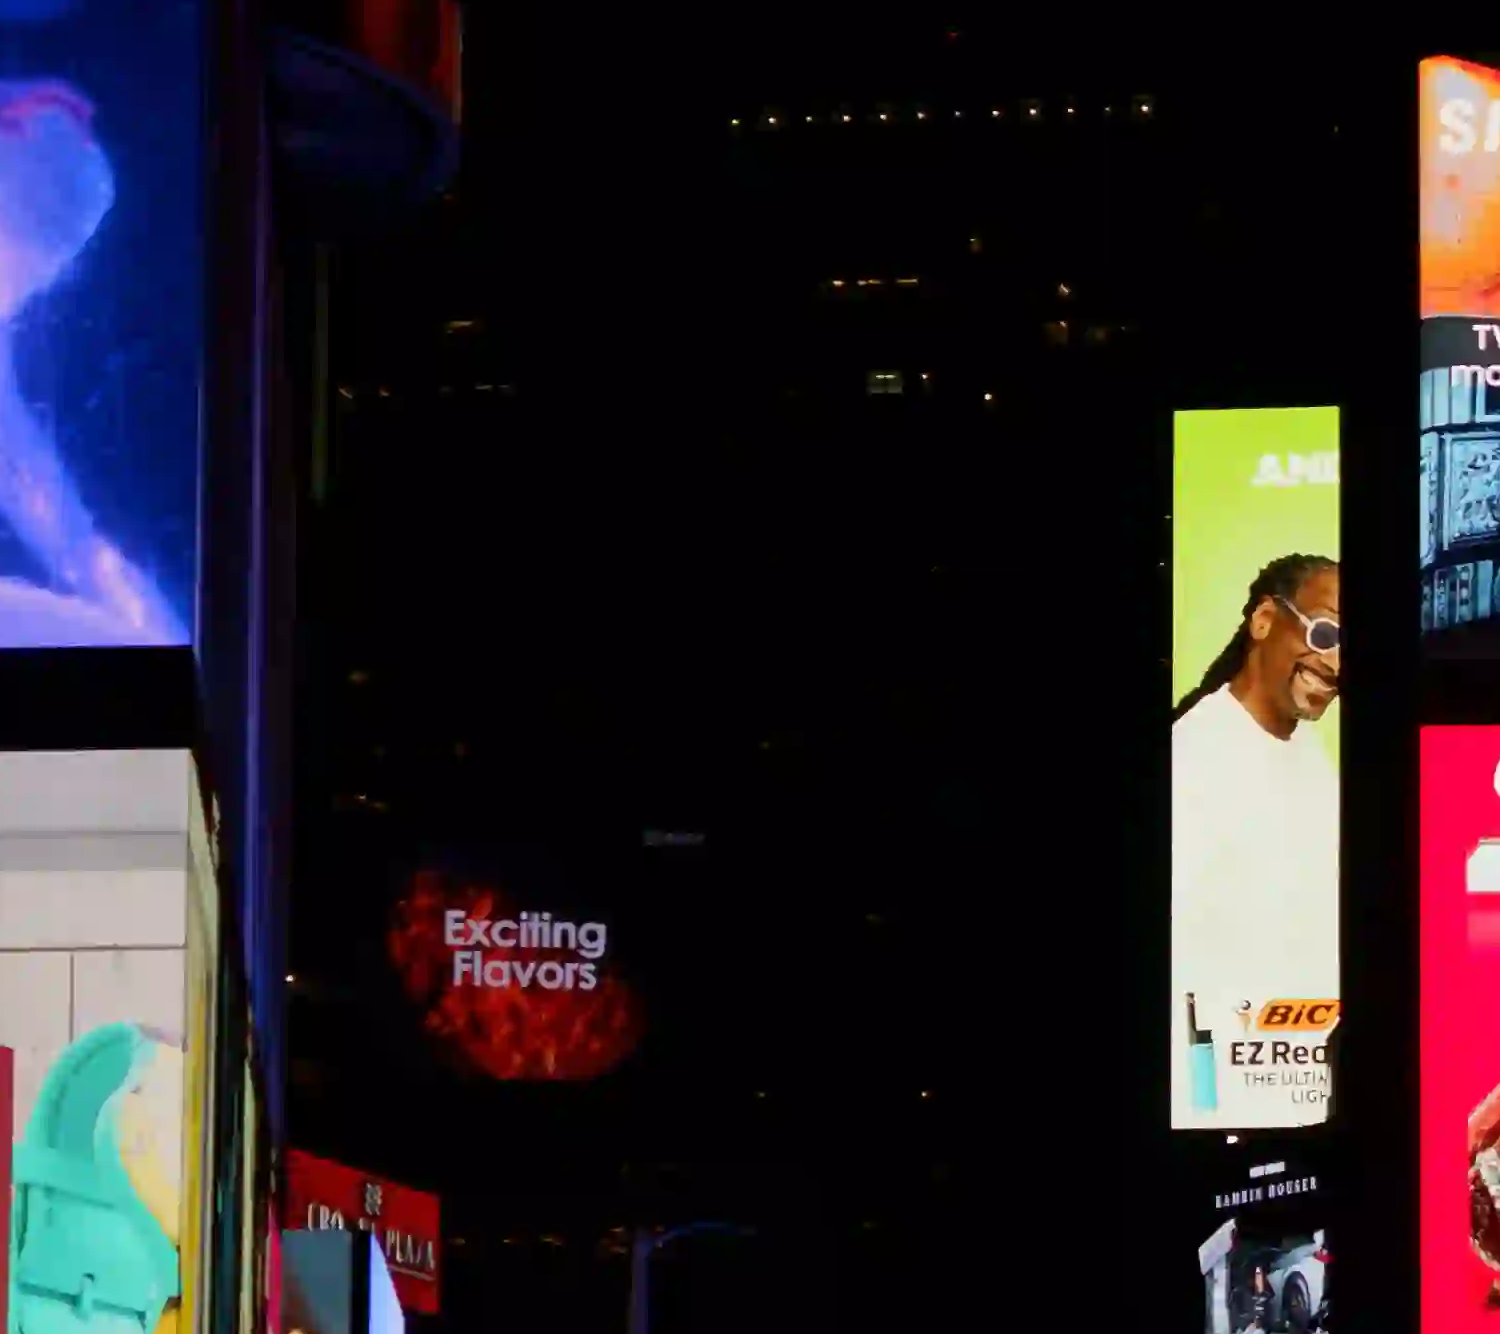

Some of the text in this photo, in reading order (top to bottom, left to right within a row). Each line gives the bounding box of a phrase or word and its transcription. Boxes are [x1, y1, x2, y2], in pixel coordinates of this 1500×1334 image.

[443, 909, 607, 958] Exciting
[452, 951, 598, 992] Flavors
[1230, 1040, 1264, 1066] EZ
[1243, 1072, 1278, 1087] THE
